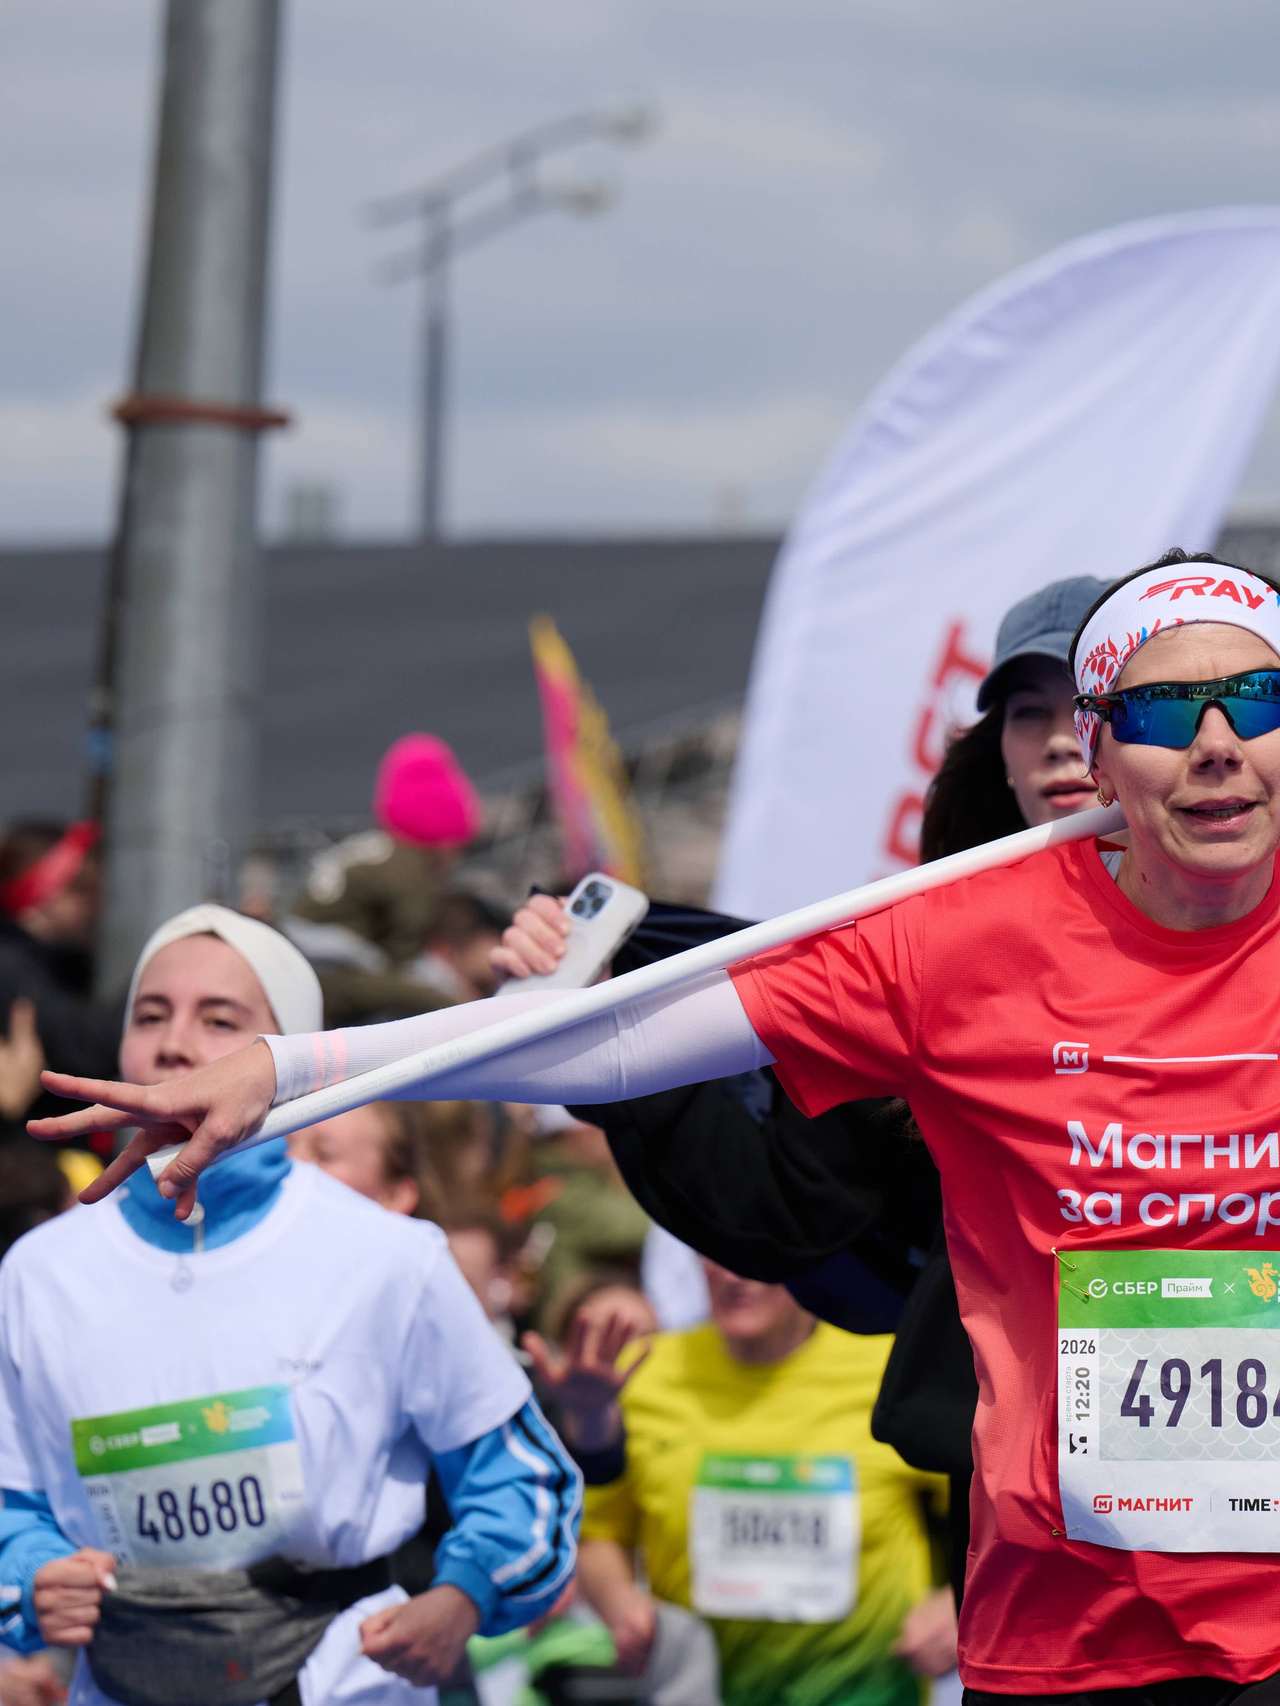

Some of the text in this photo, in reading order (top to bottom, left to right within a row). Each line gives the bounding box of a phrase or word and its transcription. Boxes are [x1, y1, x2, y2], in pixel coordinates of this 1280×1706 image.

[1056, 1188, 1123, 1226] за
[1112, 1281, 1204, 1295] СБЕР Прайм
[1061, 1339, 1096, 1355] 2026
[1075, 1366, 1090, 1422] 12:20
[137, 1474, 266, 1544] 48680
[1118, 1498, 1194, 1512] МАГНИТ
